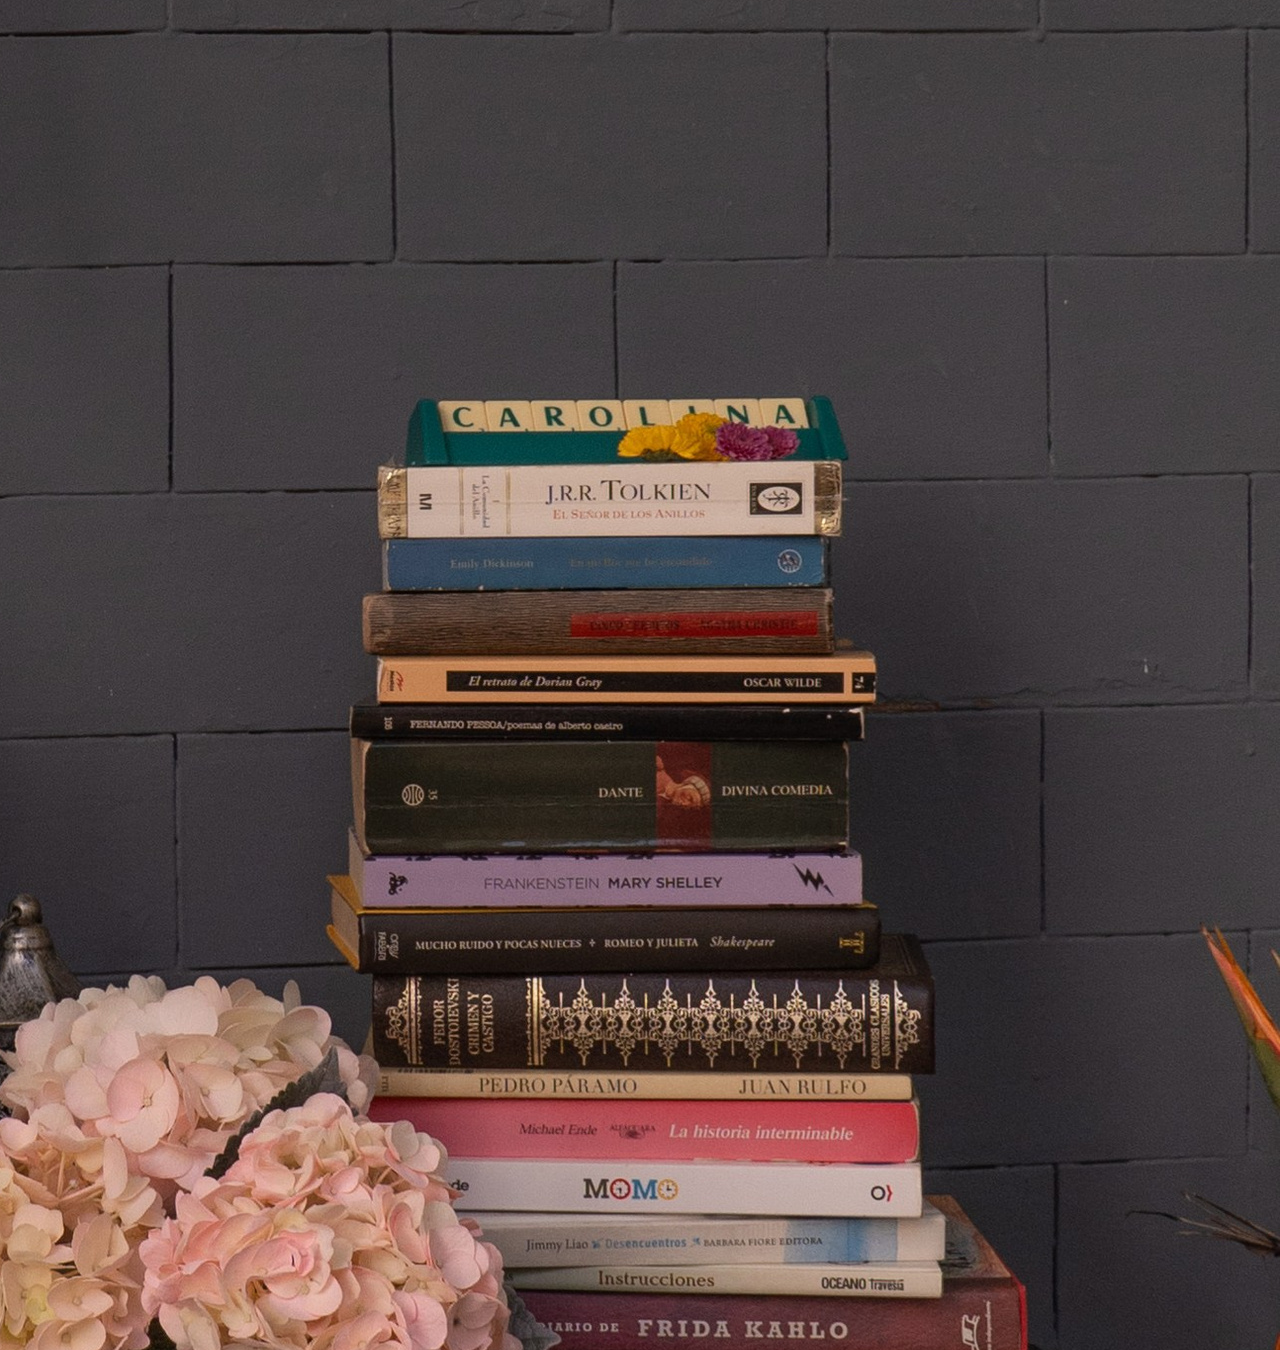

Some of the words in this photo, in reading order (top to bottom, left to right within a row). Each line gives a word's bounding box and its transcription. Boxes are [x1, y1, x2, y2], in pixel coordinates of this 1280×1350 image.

[545, 484, 597, 505] J.R.R.
[601, 479, 711, 501] TOLKIEN
[468, 675, 482, 687] El
[483, 677, 517, 687] retrato
[535, 675, 573, 687] Dorian
[576, 675, 603, 690] Gray
[743, 677, 782, 688] OSCAR
[784, 677, 822, 688] WILDE
[410, 719, 464, 730] FERNANDO
[558, 720, 592, 730] alberto
[598, 786, 643, 798] DANTE
[722, 784, 769, 797] DIVINA
[771, 784, 833, 796] COMEDIA
[483, 877, 600, 890] FRANKENSTEIN
[607, 877, 651, 889] MARY
[656, 876, 723, 889] SHELLEY
[415, 940, 457, 950] MUCHO
[459, 940, 495, 950] RUIDO
[504, 939, 539, 949] POCAS
[540, 938, 582, 949] NUECES
[604, 938, 645, 948] ROMEO
[655, 937, 699, 949] JULIETA
[709, 935, 775, 951] Shakespeare
[433, 999, 445, 1045] FEDOR
[447, 978, 461, 1066] DOSTOIEVSKI
[467, 1005, 480, 1056] CRIMEN
[481, 993, 495, 1053] CASTIGO
[479, 1077, 546, 1094] PEDRO
[552, 1072, 638, 1094] PÁRAMO
[739, 1078, 791, 1095] JUAN
[797, 1079, 867, 1095] RULFO
[519, 1122, 565, 1135] Michael
[568, 1123, 598, 1136] Ende
[669, 1123, 688, 1139] La
[693, 1123, 750, 1140] historia
[755, 1124, 854, 1142] interminable
[526, 1238, 562, 1253] Jimmy
[605, 1237, 687, 1249] Desencuentros
[703, 1237, 746, 1247] BARBARA
[748, 1236, 777, 1246] FIORE
[779, 1235, 823, 1246] EDITORA
[597, 1270, 715, 1287] Instrucciones
[821, 1277, 866, 1291] OCEANO
[541, 1322, 593, 1333] IARIO
[599, 1322, 619, 1333] DE
[637, 1319, 731, 1338] FRIDA
[745, 1320, 849, 1339] KAHLO
